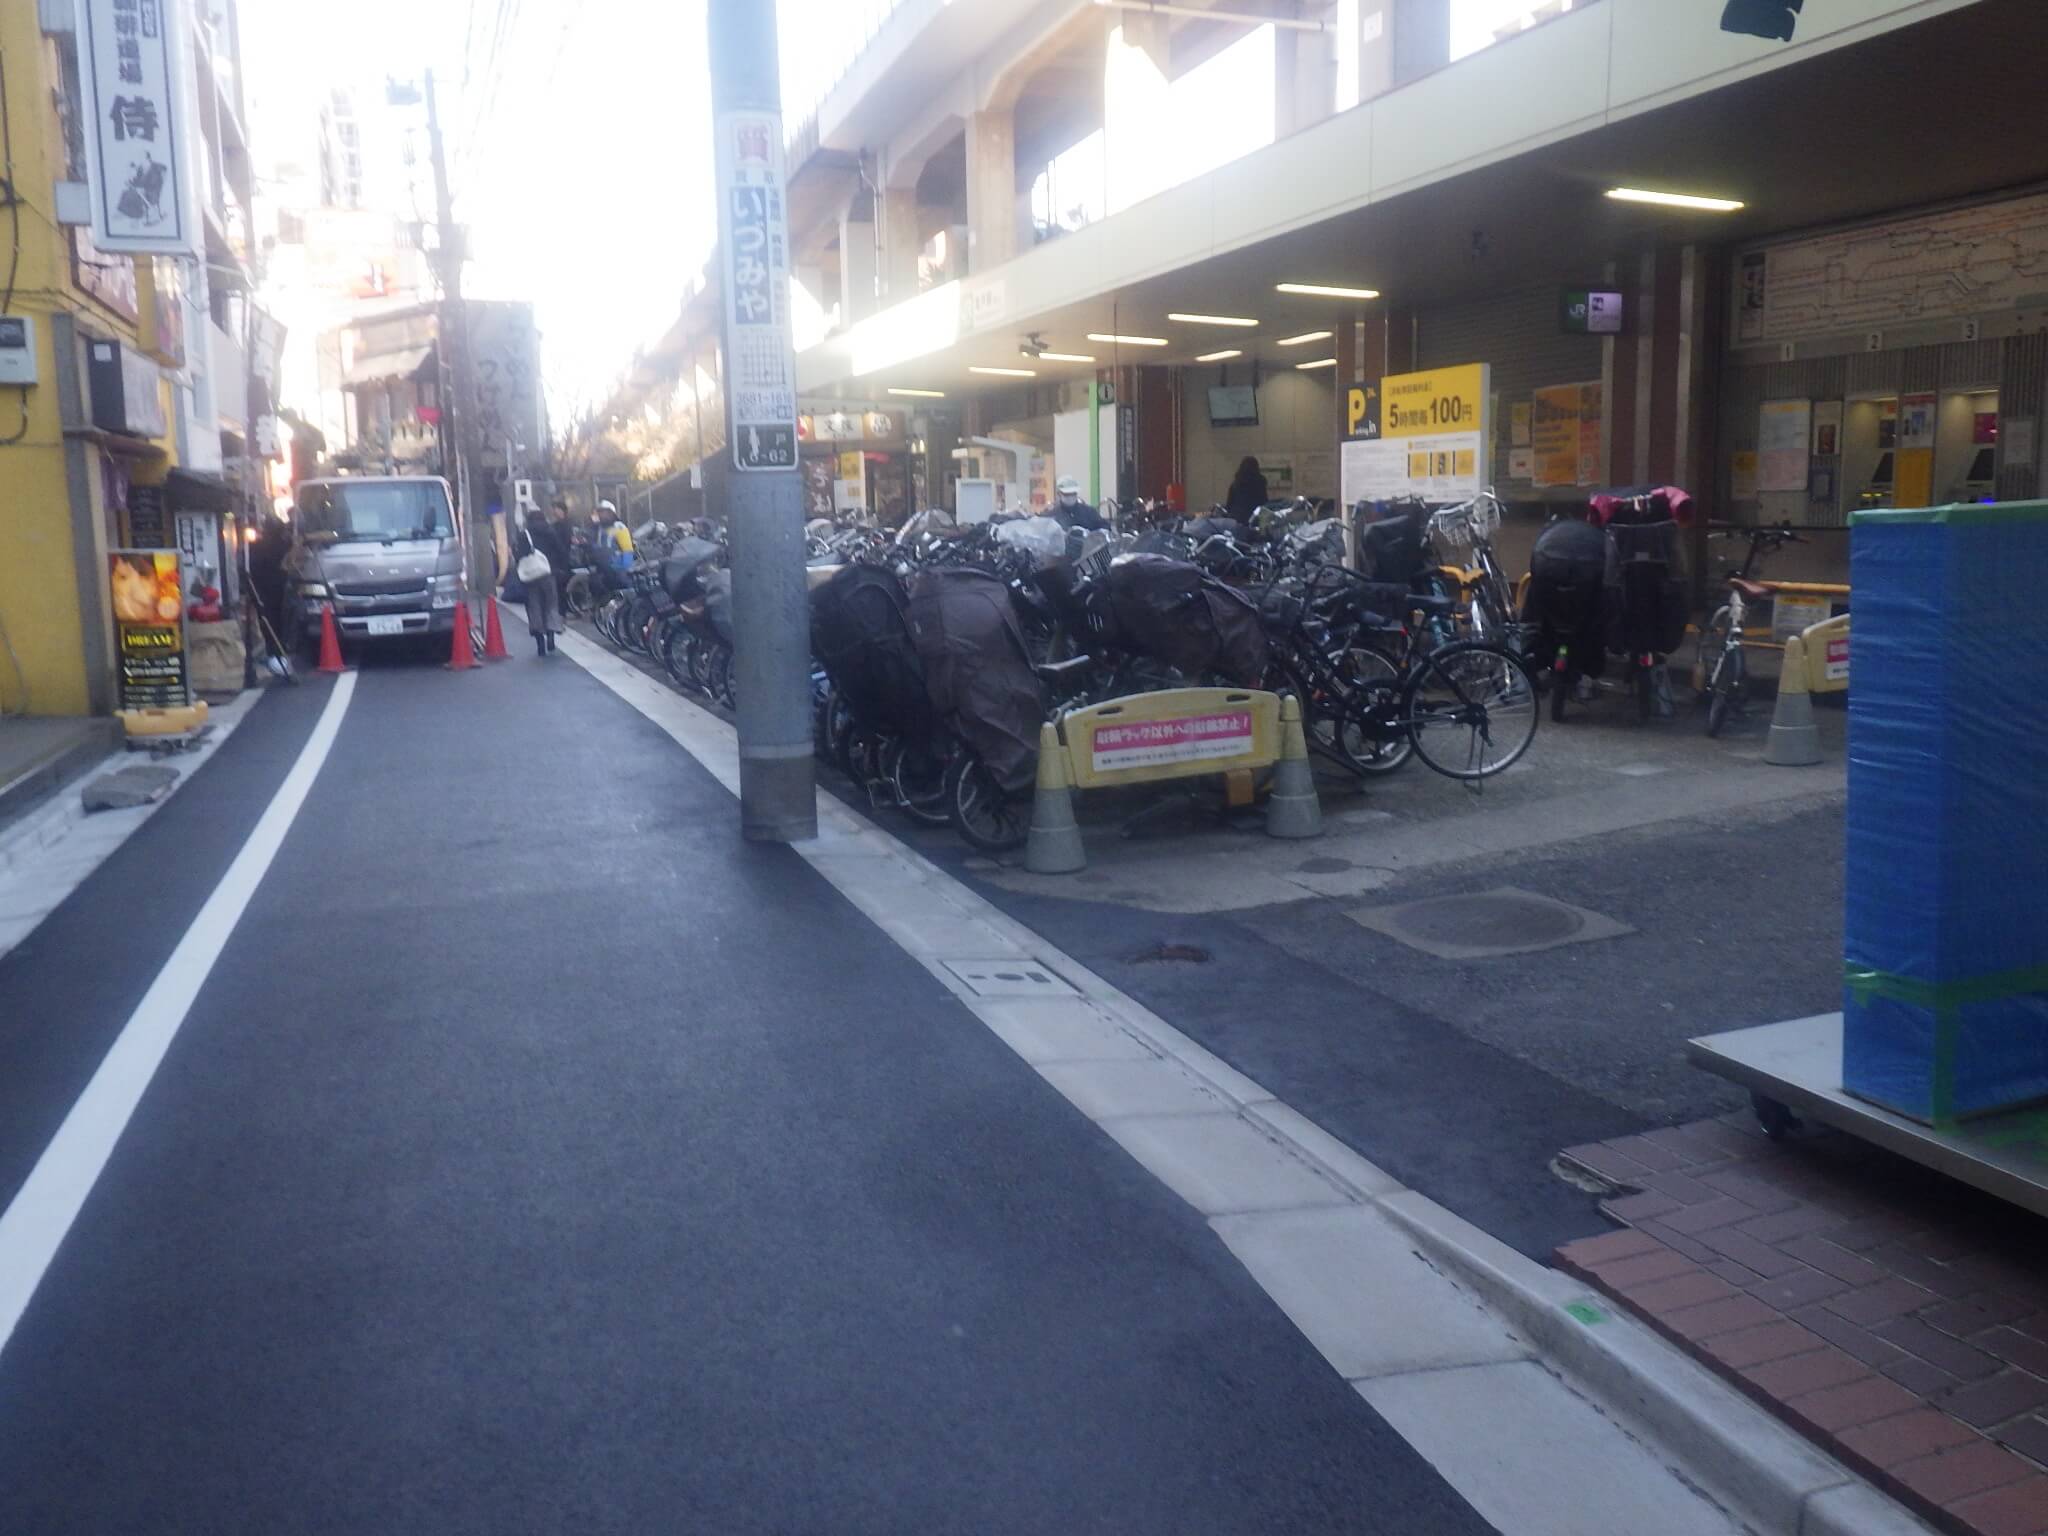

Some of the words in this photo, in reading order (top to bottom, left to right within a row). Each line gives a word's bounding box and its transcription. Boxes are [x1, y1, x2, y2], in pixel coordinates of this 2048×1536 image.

[110, 95, 160, 142] 侍
[734, 189, 769, 321] いづみや
